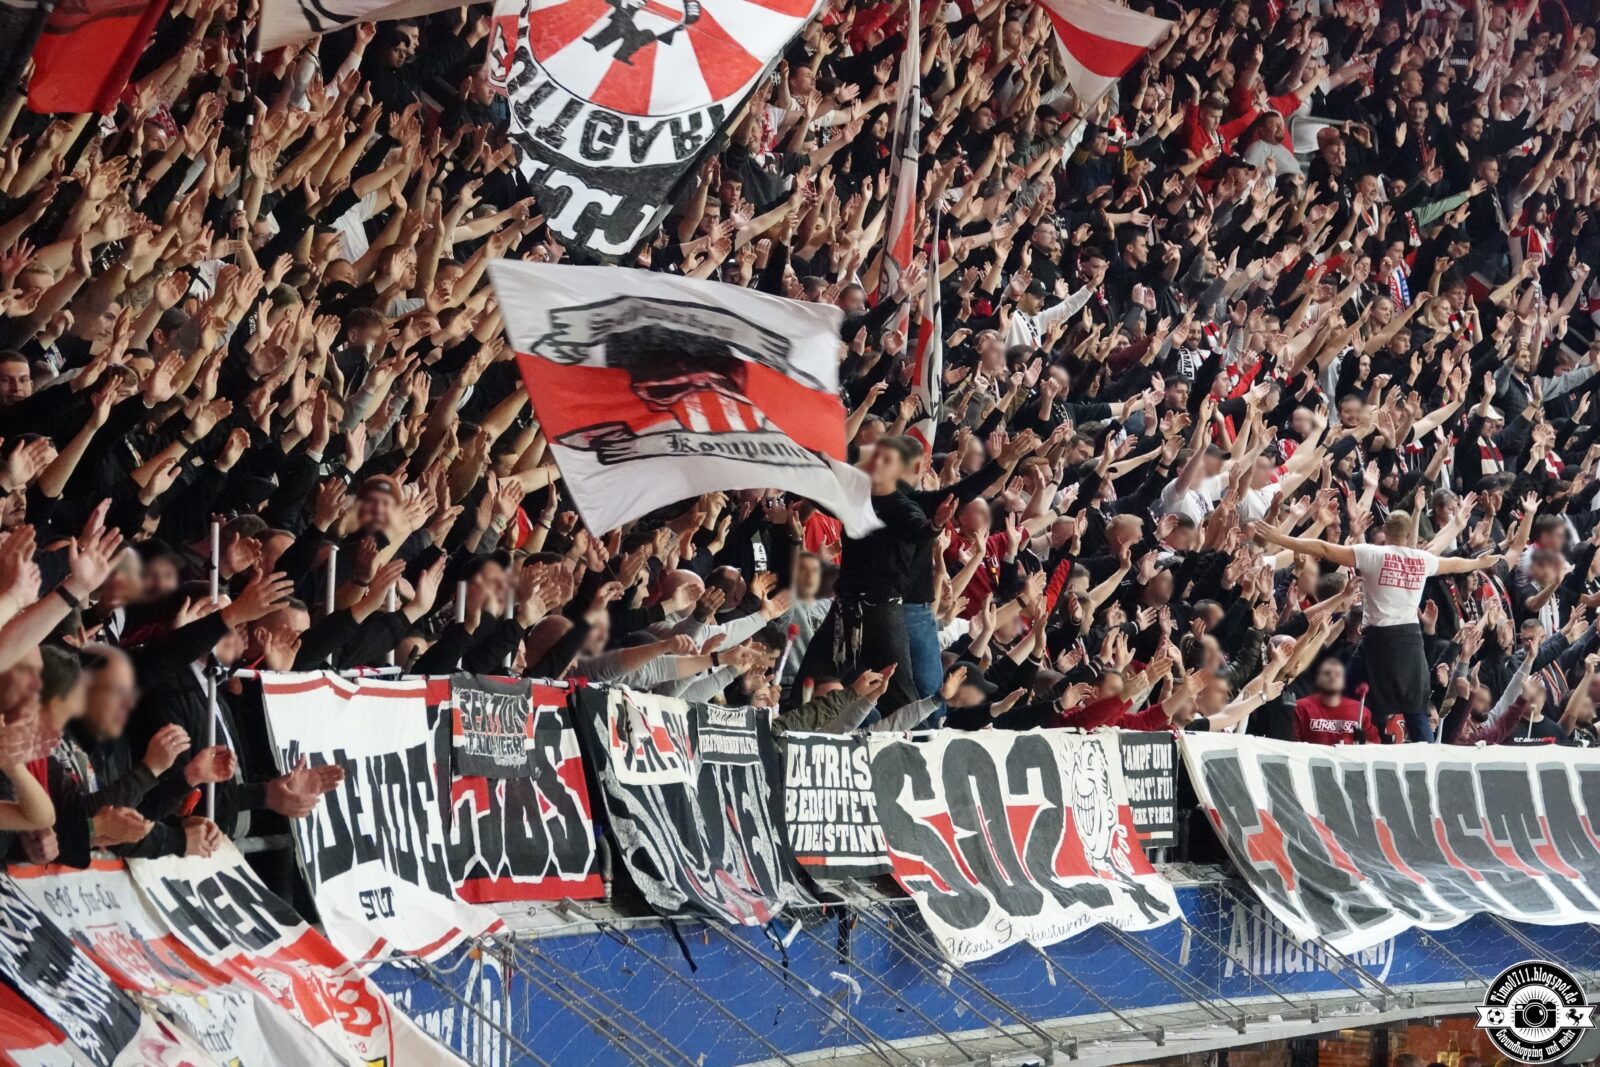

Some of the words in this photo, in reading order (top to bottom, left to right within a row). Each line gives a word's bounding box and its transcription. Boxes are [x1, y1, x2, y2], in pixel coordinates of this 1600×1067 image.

[786, 743, 872, 790] ULTRAS
[785, 789, 879, 823] BEDEUTET
[1224, 904, 1344, 978] Allian
